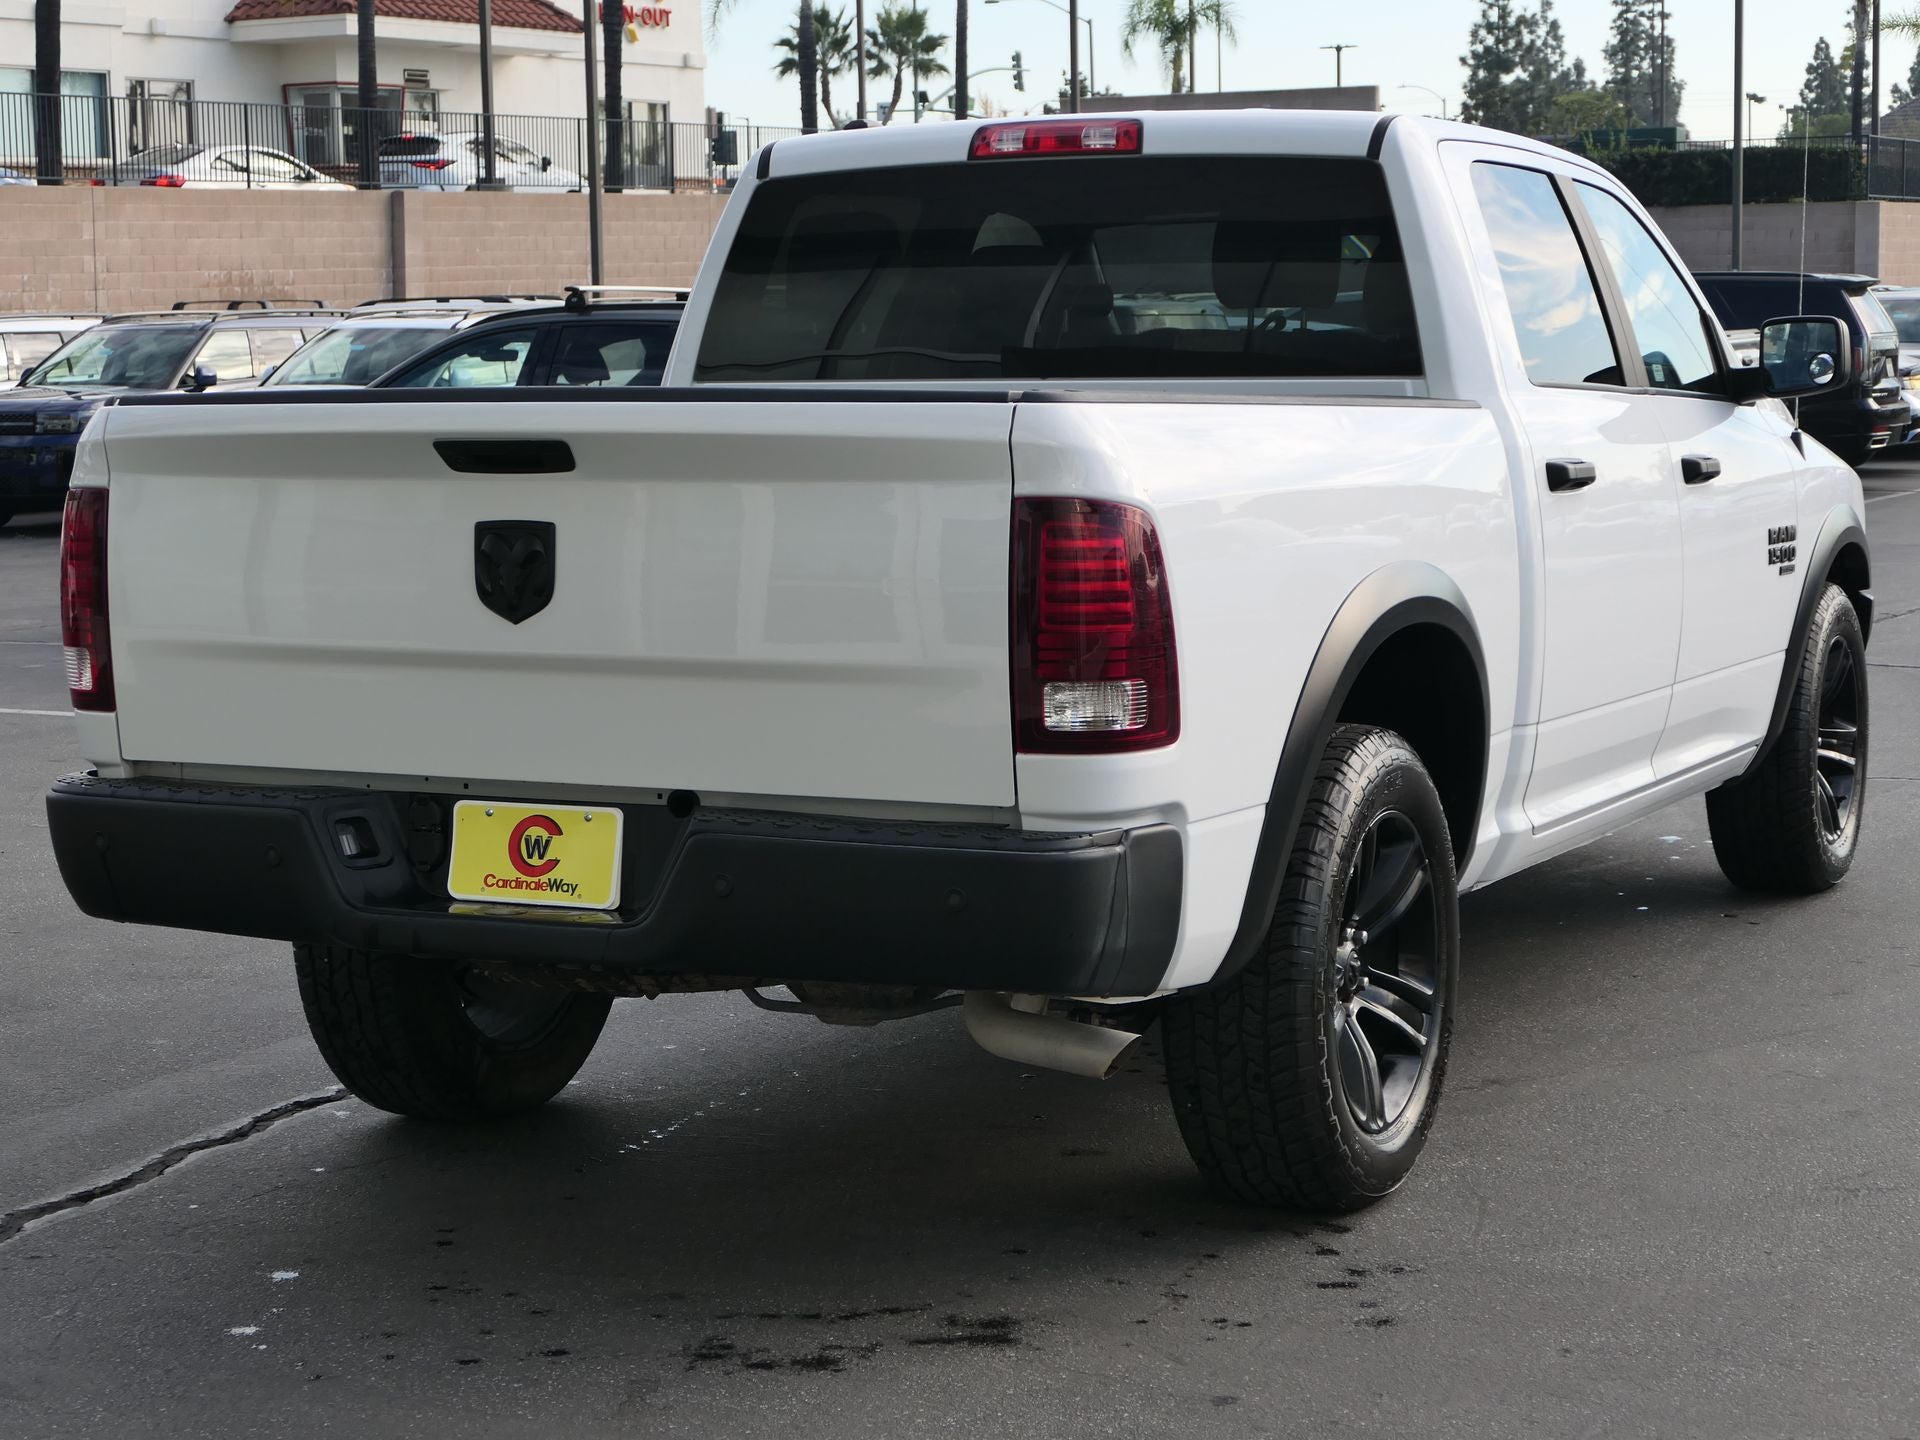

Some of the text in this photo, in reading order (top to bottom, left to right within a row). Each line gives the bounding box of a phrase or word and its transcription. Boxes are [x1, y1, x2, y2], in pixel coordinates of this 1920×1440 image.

[1768, 525, 1796, 545] RAM
[1768, 544, 1796, 565] 1500
[483, 873, 579, 896] CardinaleWay
